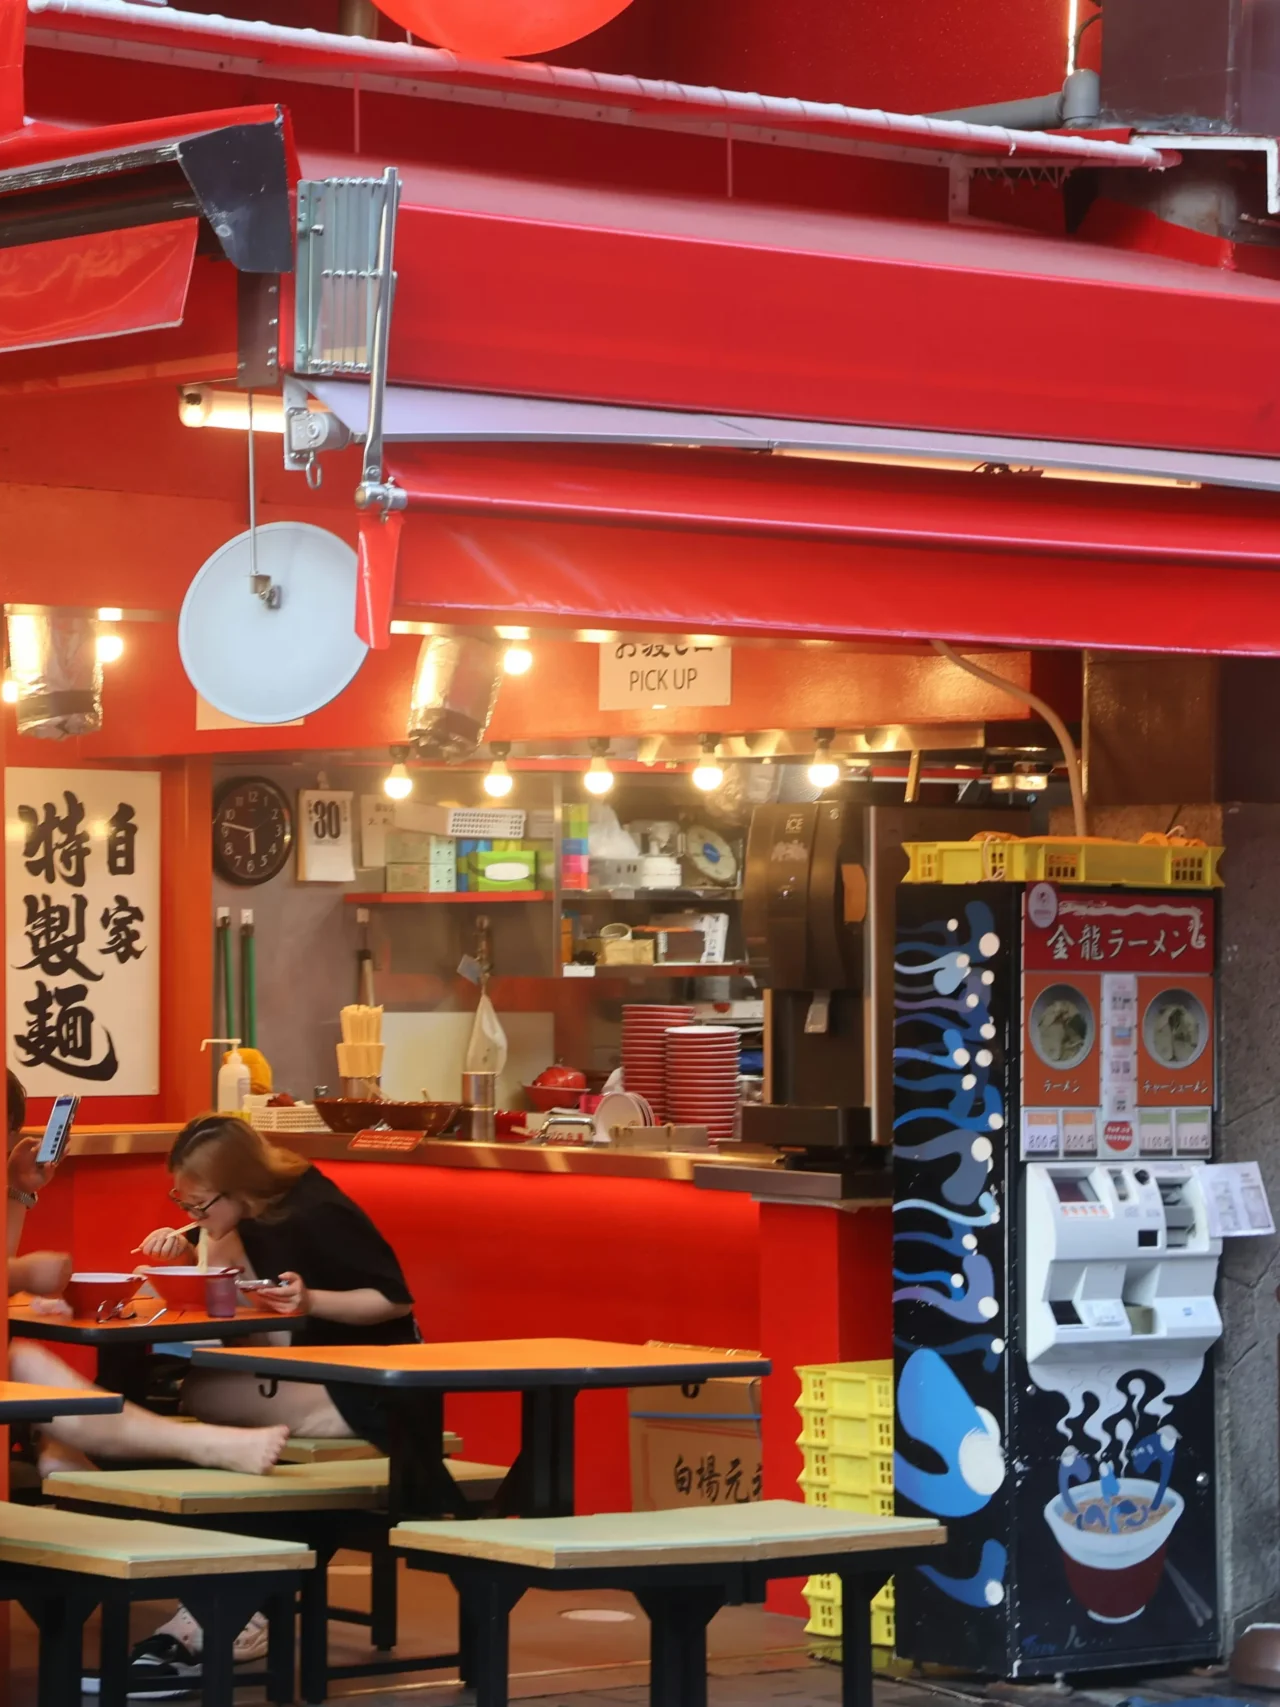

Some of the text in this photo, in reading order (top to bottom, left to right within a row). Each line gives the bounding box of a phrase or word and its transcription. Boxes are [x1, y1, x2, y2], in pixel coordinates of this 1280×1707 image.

[629, 667, 698, 692] PICK UP
[248, 791, 259, 802] 12
[225, 808, 236, 820] 10
[271, 808, 279, 820] 2
[313, 801, 341, 839] 30
[785, 818, 804, 830] ICE
[275, 825, 283, 837] 3
[224, 843, 233, 855] 8
[269, 843, 277, 854] 4
[234, 856, 242, 867] 7
[247, 860, 255, 872] 6
[260, 855, 268, 867] 5
[97, 802, 148, 965] 自家
[11, 790, 118, 1082] 特製麺
[1046, 924, 1187, 961] 金龍ラーメン
[1043, 1079, 1080, 1093] ラーメン
[1143, 1080, 1208, 1094] チャーシューメン
